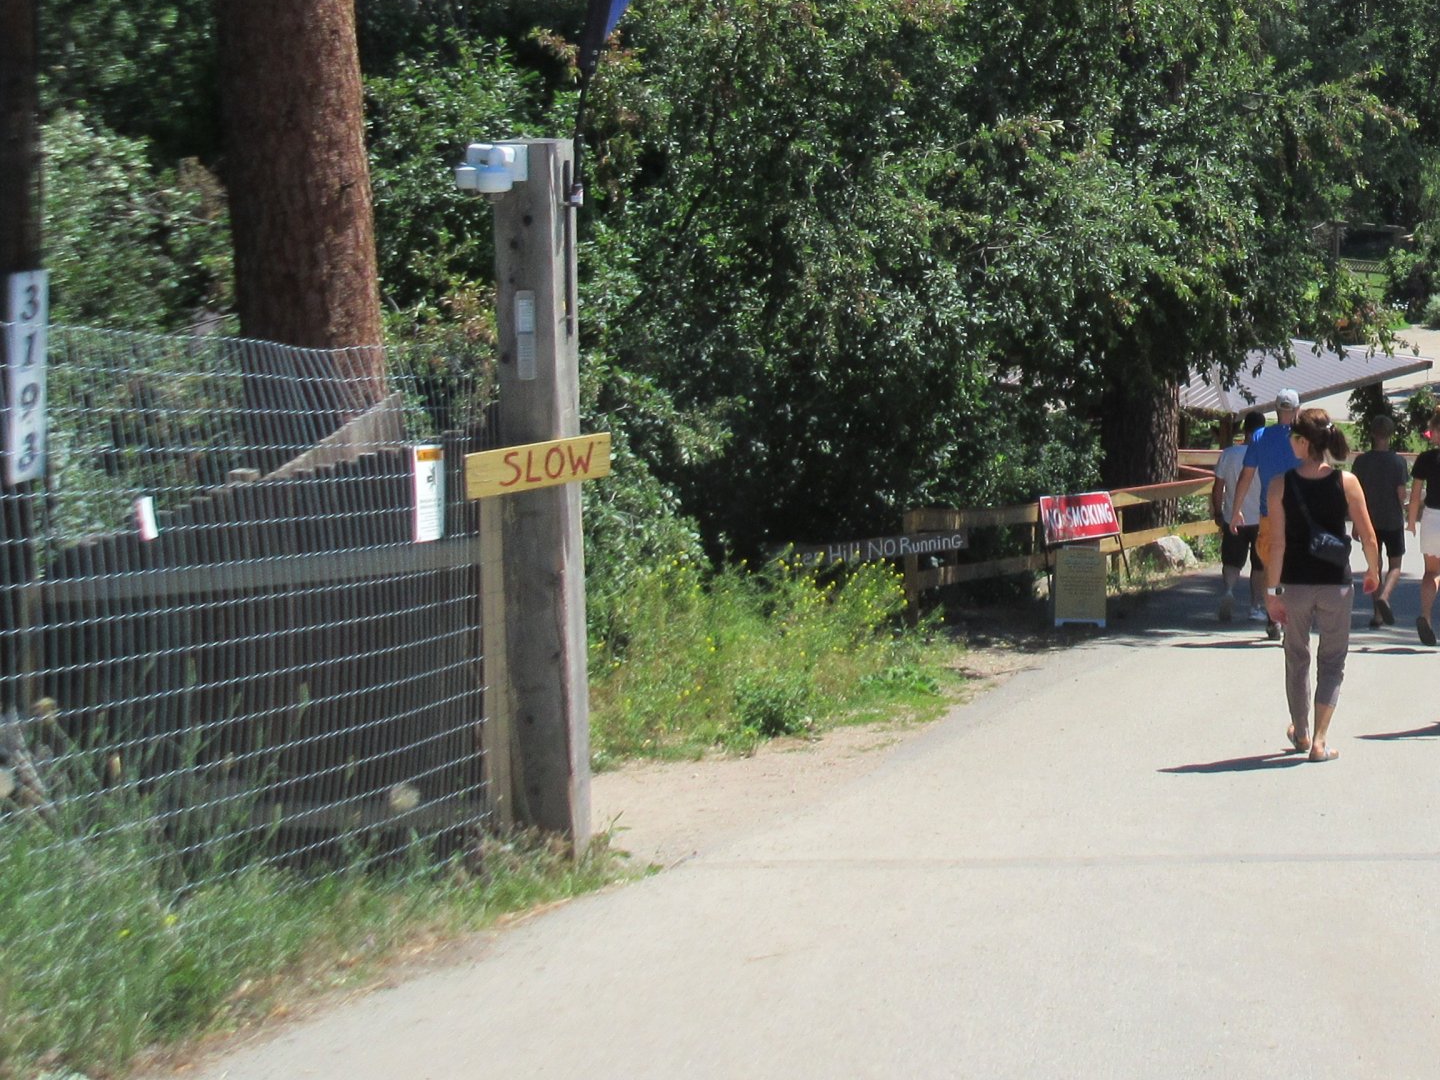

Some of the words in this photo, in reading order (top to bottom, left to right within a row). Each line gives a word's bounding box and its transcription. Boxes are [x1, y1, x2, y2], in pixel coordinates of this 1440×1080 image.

[499, 441, 595, 487] SLOW
[1046, 508, 1063, 529] NO
[1066, 502, 1113, 527] SMOKING
[867, 536, 896, 559] NO
